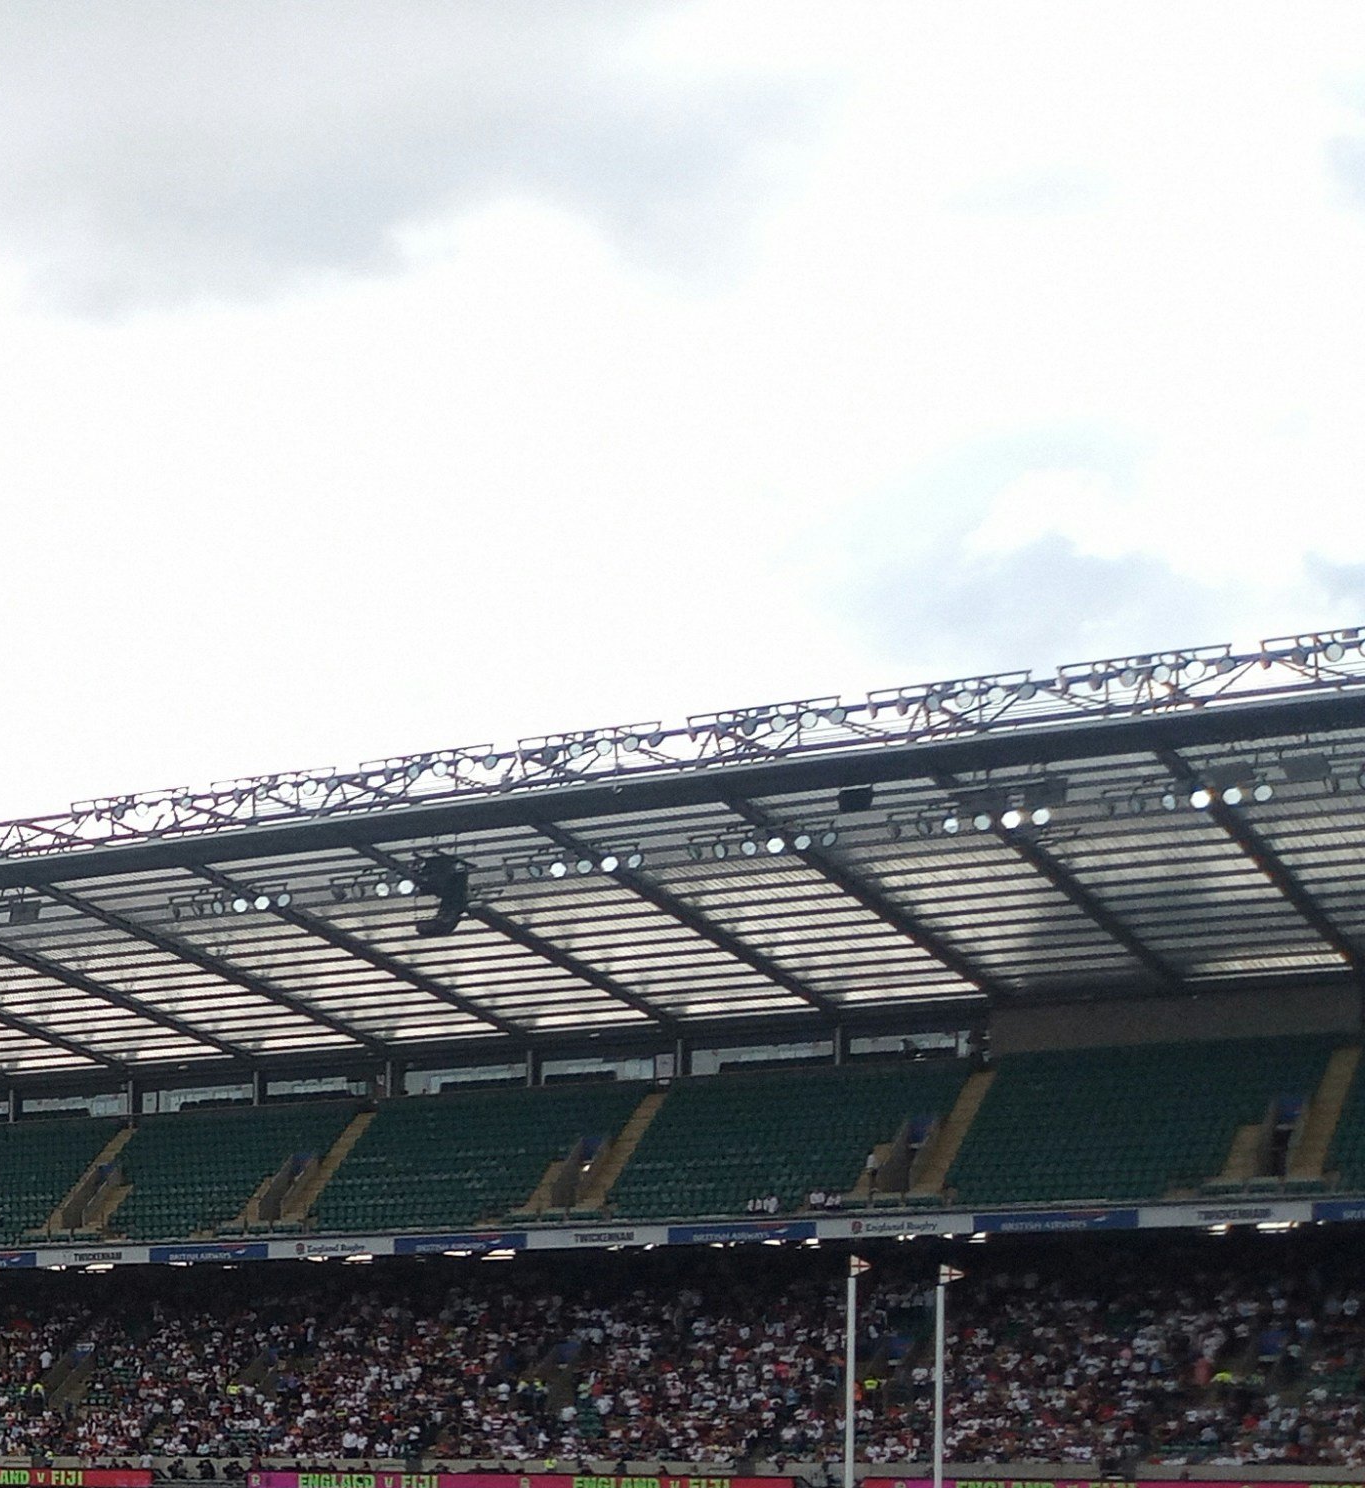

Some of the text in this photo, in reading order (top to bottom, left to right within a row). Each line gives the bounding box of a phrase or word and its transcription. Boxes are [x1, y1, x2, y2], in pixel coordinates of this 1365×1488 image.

[866, 1219, 938, 1233] England Rugby
[74, 1251, 122, 1262] TWICKENHAM
[51, 1470, 83, 1485] FIJI
